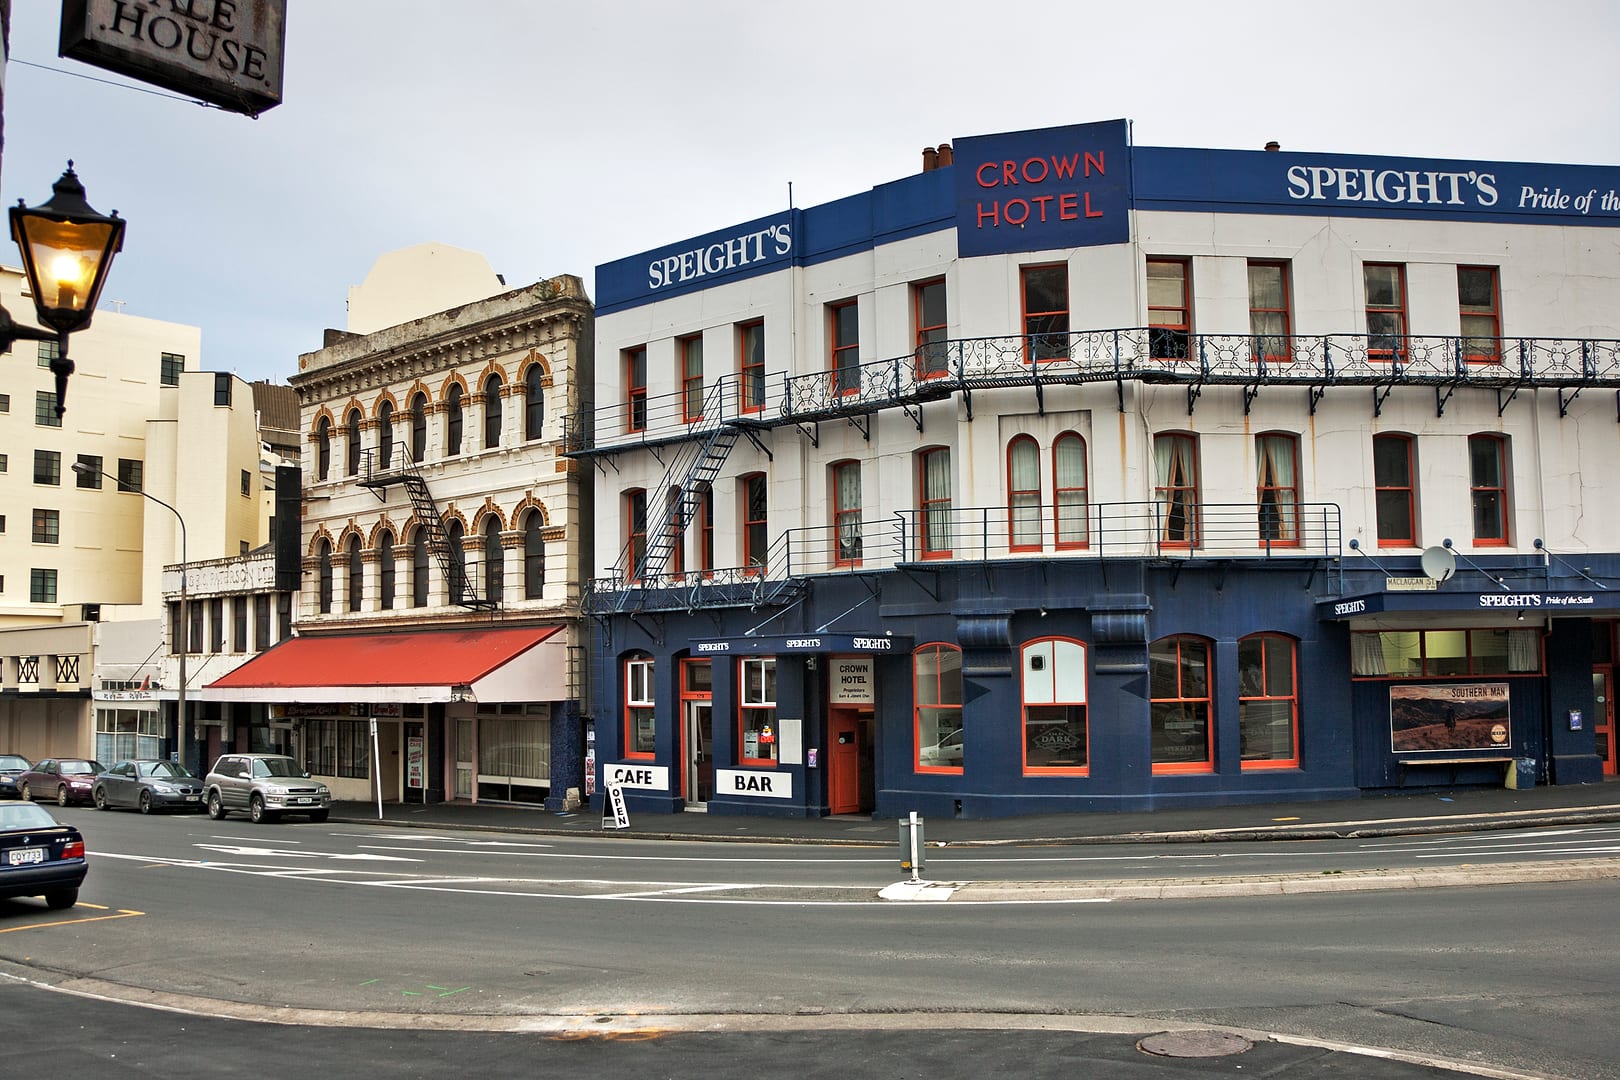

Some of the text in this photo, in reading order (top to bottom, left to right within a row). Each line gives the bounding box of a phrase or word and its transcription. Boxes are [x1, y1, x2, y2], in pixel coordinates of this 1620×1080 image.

[976, 151, 1105, 188] CROWN
[1286, 165, 1620, 215] SPEIGHT'S Pride of th
[976, 192, 1104, 229] HOTEL
[648, 223, 792, 289] SPEIGHT'S
[1334, 600, 1365, 615] SPEIGHT'S
[1480, 594, 1541, 607] SPEIGHT'S
[1545, 596, 1561, 605] Pride
[1560, 596, 1569, 605] of
[1577, 596, 1594, 605] South
[698, 642, 729, 652] SPEIGHT'S
[786, 639, 821, 648] SPEIGHT'S
[853, 637, 891, 650] SPEIGHT'S
[840, 665, 868, 673] CROWN
[841, 676, 867, 684] HOTEL
[1451, 686, 1506, 698] SOUTHERN MAN
[1041, 735, 1071, 743] DARK
[614, 769, 653, 785] CAFE
[734, 775, 773, 792] BAR
[612, 788, 627, 826] OPEN
